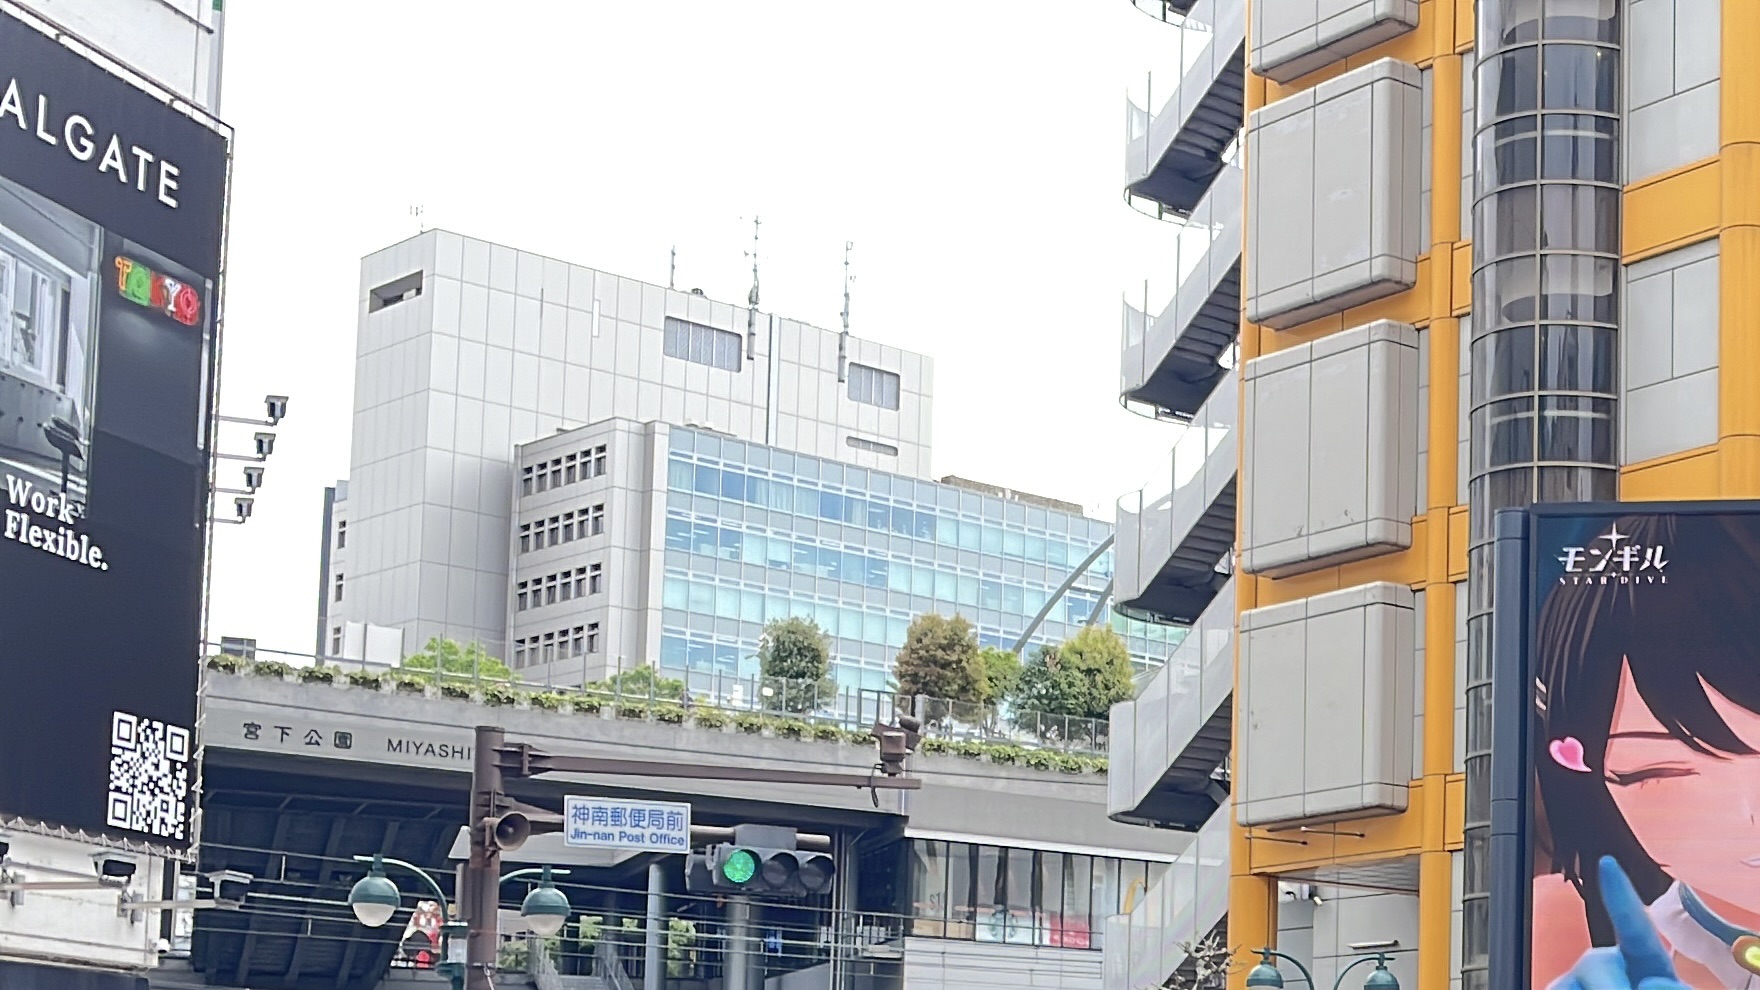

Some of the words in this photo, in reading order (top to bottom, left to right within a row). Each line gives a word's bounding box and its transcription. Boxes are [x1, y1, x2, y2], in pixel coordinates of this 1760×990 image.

[6, 474, 73, 525] Work
[4, 509, 109, 571] Flexible.
[243, 721, 353, 750] 宮下公園
[571, 803, 684, 832] 神南郵便局前
[570, 828, 615, 842] Jin-nan
[618, 830, 645, 844] Post
[649, 832, 685, 847] Office
